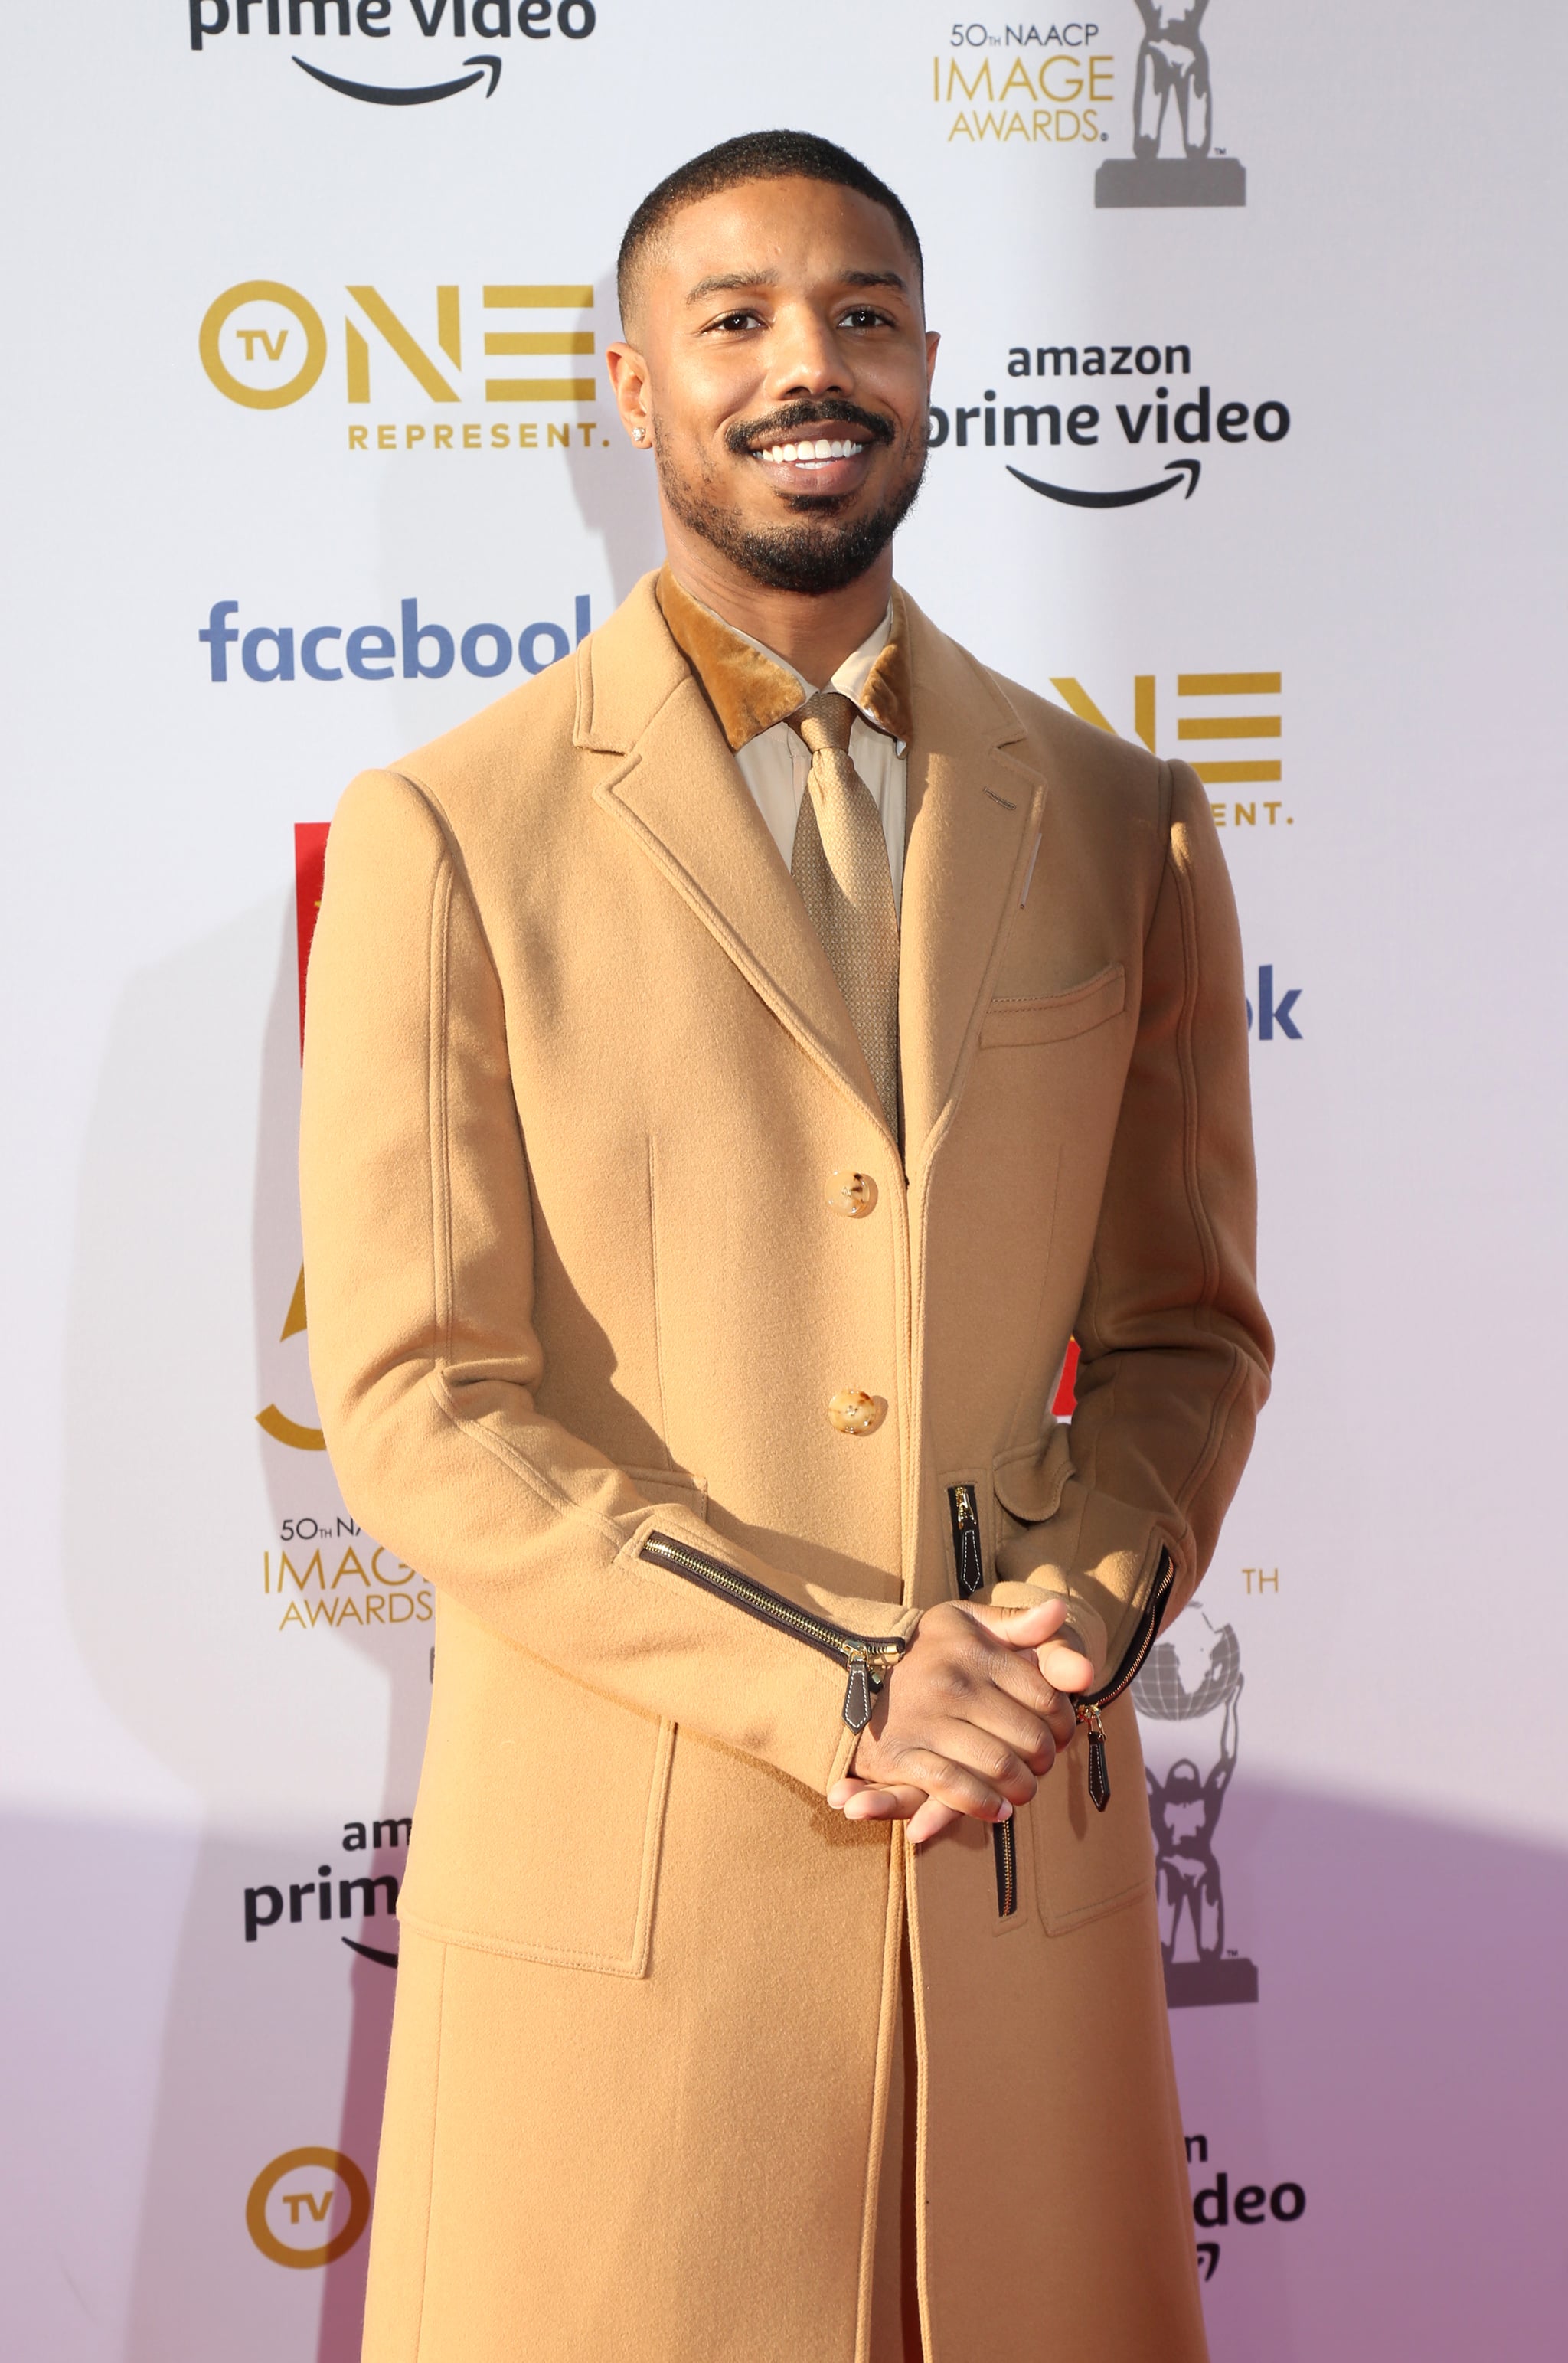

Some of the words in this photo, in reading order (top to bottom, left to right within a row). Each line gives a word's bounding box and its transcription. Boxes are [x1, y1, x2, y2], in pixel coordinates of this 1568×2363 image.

[1005, 24, 1099, 46] NAACP
[933, 54, 1114, 102] IMAGE
[198, 279, 596, 410] ONE
[237, 329, 289, 361] TV
[1008, 345, 1191, 377] amazon
[1116, 386, 1290, 443] video
[348, 422, 610, 450] REPRESENT.
[280, 1518, 332, 1541] 50TH
[264, 1545, 431, 1594] IMAG
[279, 1590, 433, 1632] AWARDS
[244, 1865, 399, 1943] prim
[283, 2191, 334, 2224] TV
[1193, 2172, 1306, 2228] deo
